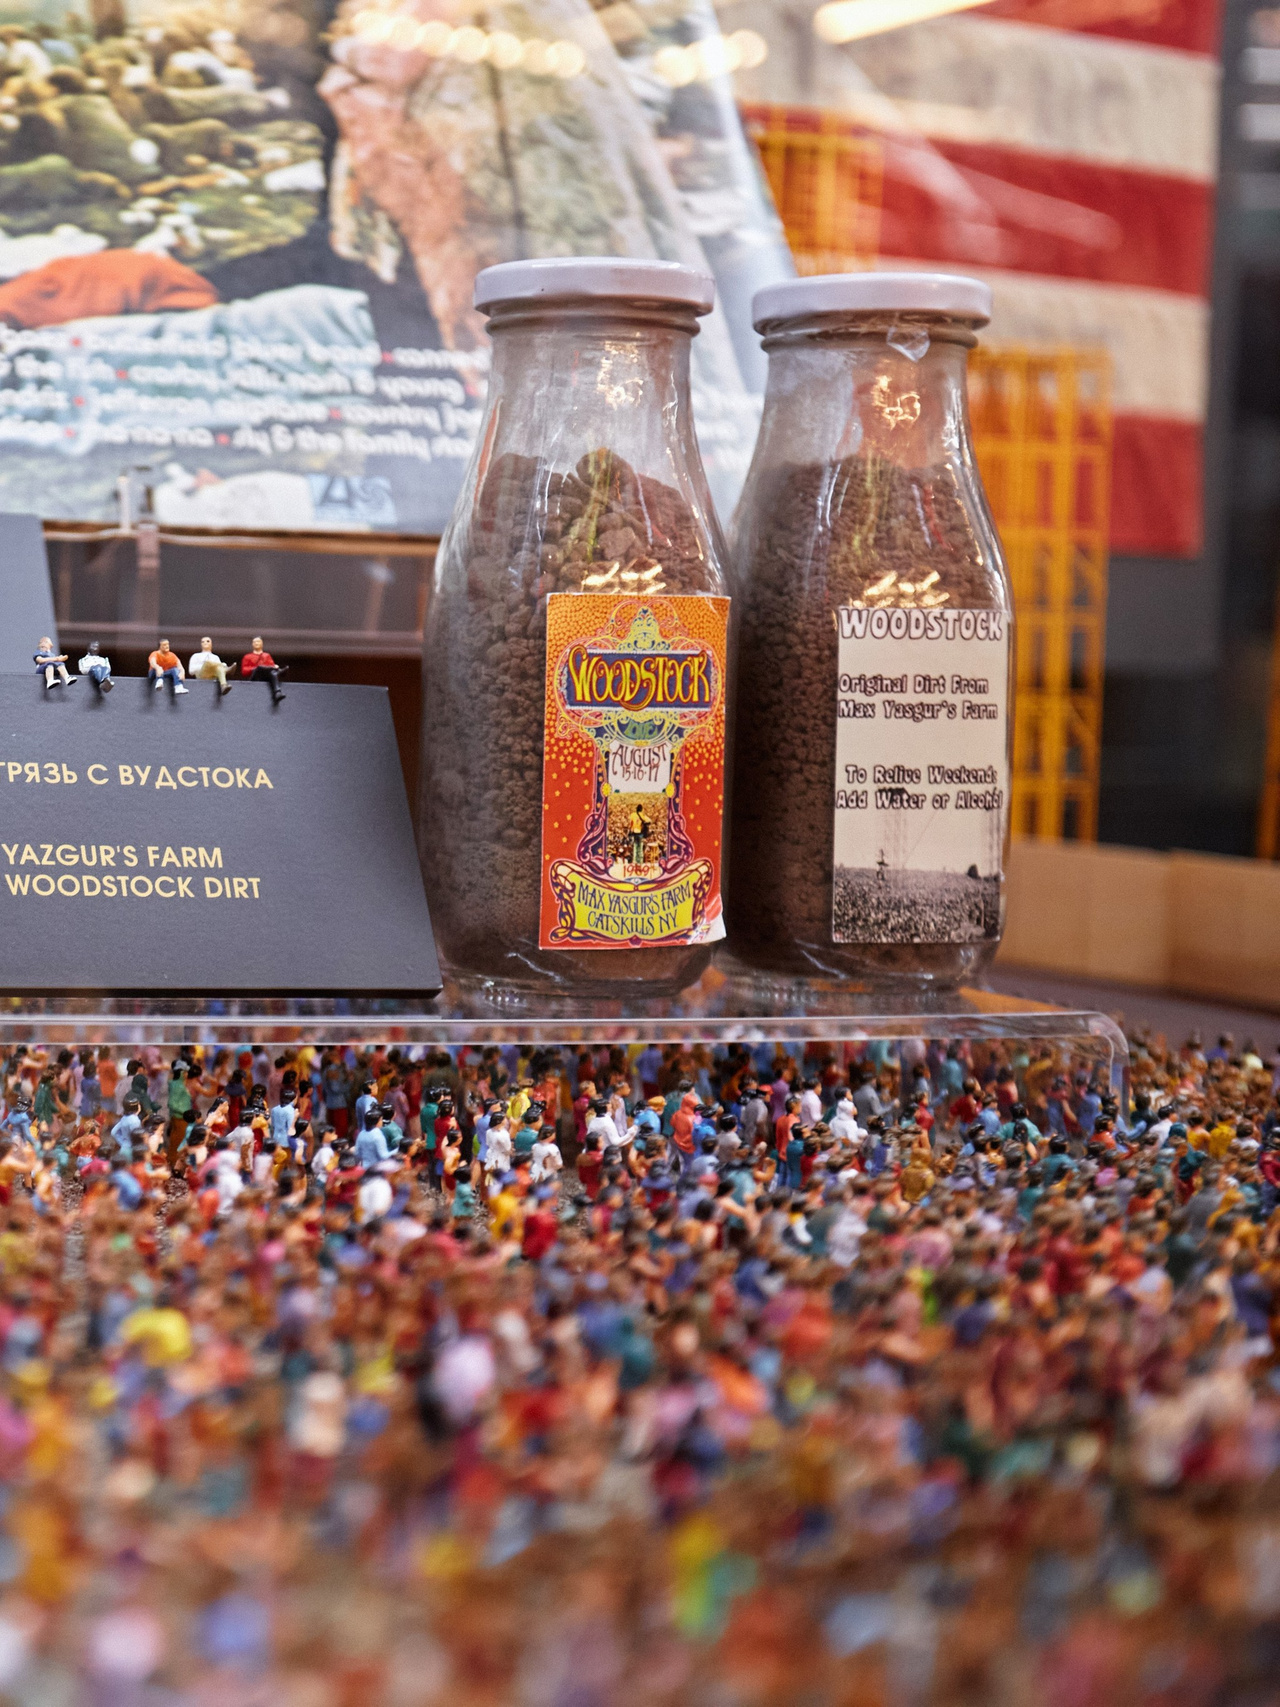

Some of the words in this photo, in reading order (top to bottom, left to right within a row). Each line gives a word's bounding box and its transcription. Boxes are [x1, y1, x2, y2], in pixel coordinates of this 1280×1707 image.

[378, 376, 465, 405] young
[295, 427, 343, 454] the
[343, 429, 432, 462] family
[840, 608, 1003, 641] WOODSTOCK
[568, 644, 711, 711] WOODSTOCK
[838, 674, 908, 697] Original
[913, 675, 946, 694] Dirt
[951, 675, 989, 695] From
[838, 699, 876, 719] Max
[882, 700, 957, 722] Yasgur's
[962, 701, 998, 720] Farm
[612, 743, 668, 774] AUGUST
[87, 763, 110, 785] С
[119, 764, 274, 790] ВУДСТОКА
[845, 764, 867, 784] To
[873, 764, 922, 784] Relive
[836, 790, 868, 810] Add
[875, 790, 926, 810] Water
[932, 794, 950, 810] or
[1, 843, 139, 867] YAZGUR'S
[147, 846, 223, 869] FARM
[4, 874, 195, 898] WOODSTOCK
[204, 877, 261, 899] DIRT
[577, 880, 605, 910] MAX
[661, 881, 693, 912] FARM
[588, 910, 654, 936] CATSKILLS
[658, 909, 678, 934] NY
